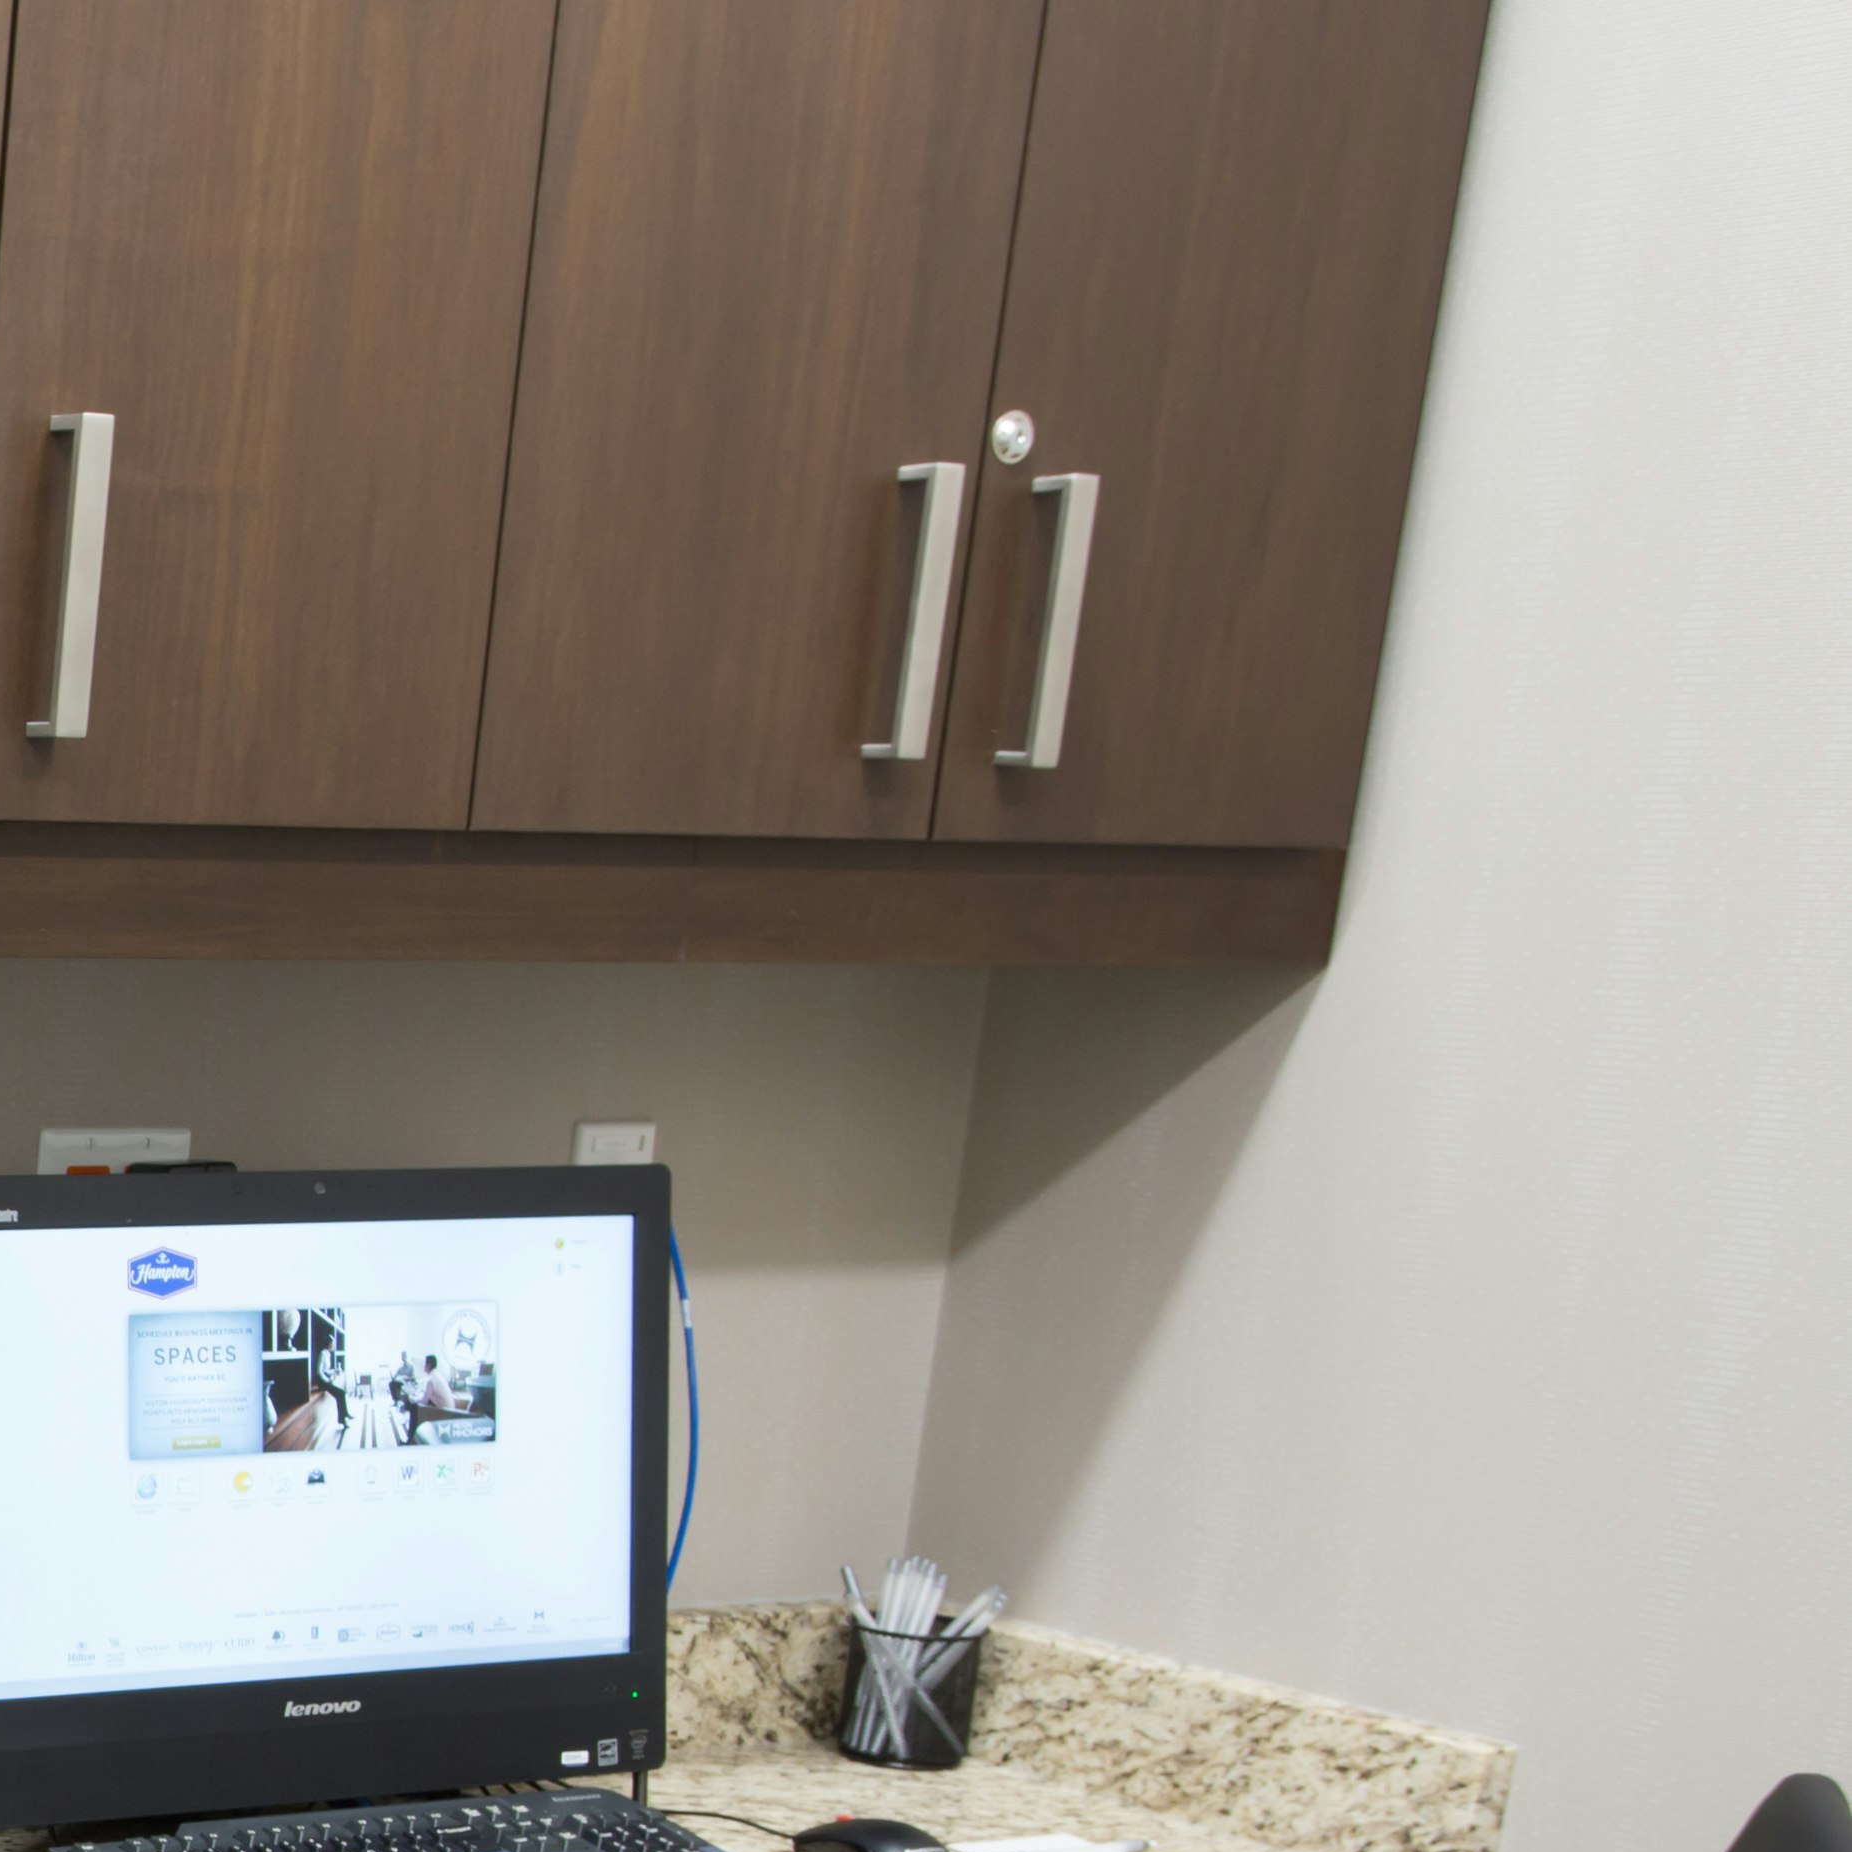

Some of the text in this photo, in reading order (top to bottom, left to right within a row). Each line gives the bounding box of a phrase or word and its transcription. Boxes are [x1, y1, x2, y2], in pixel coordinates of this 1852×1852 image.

[130, 1262, 195, 1285] Hampton
[154, 1344, 237, 1366] SPACES
[283, 1700, 362, 1718] lenovo
